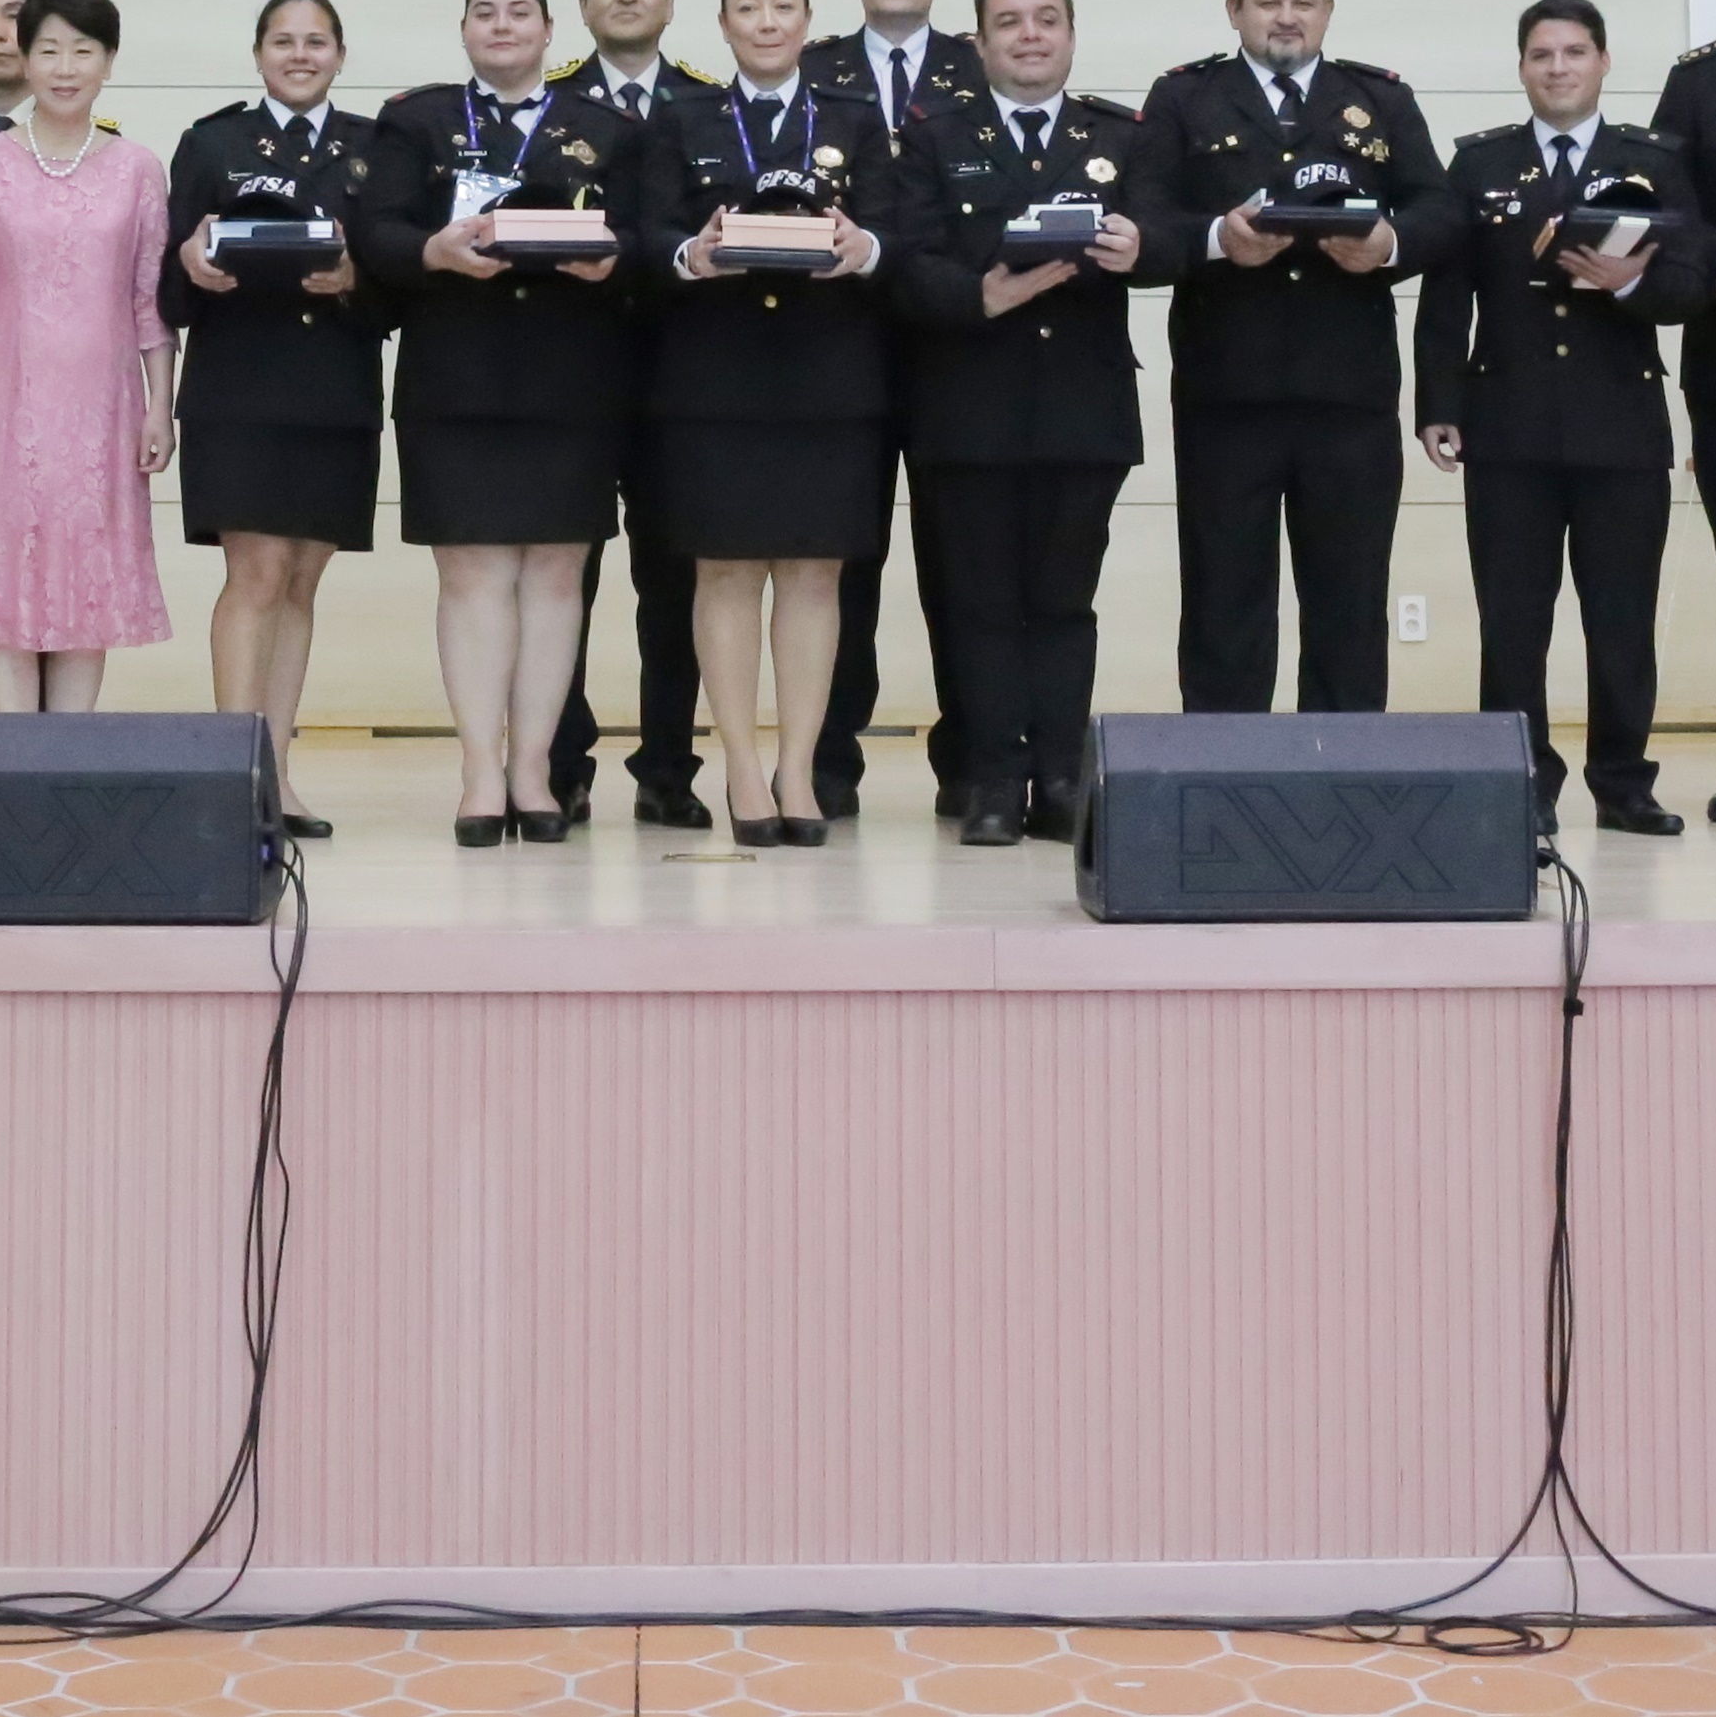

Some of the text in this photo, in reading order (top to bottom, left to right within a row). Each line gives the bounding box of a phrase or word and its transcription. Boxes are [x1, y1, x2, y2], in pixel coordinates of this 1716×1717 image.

[237, 175, 295, 198] GFSA
[756, 169, 816, 195] GFSA
[1293, 163, 1352, 190] GFSA
